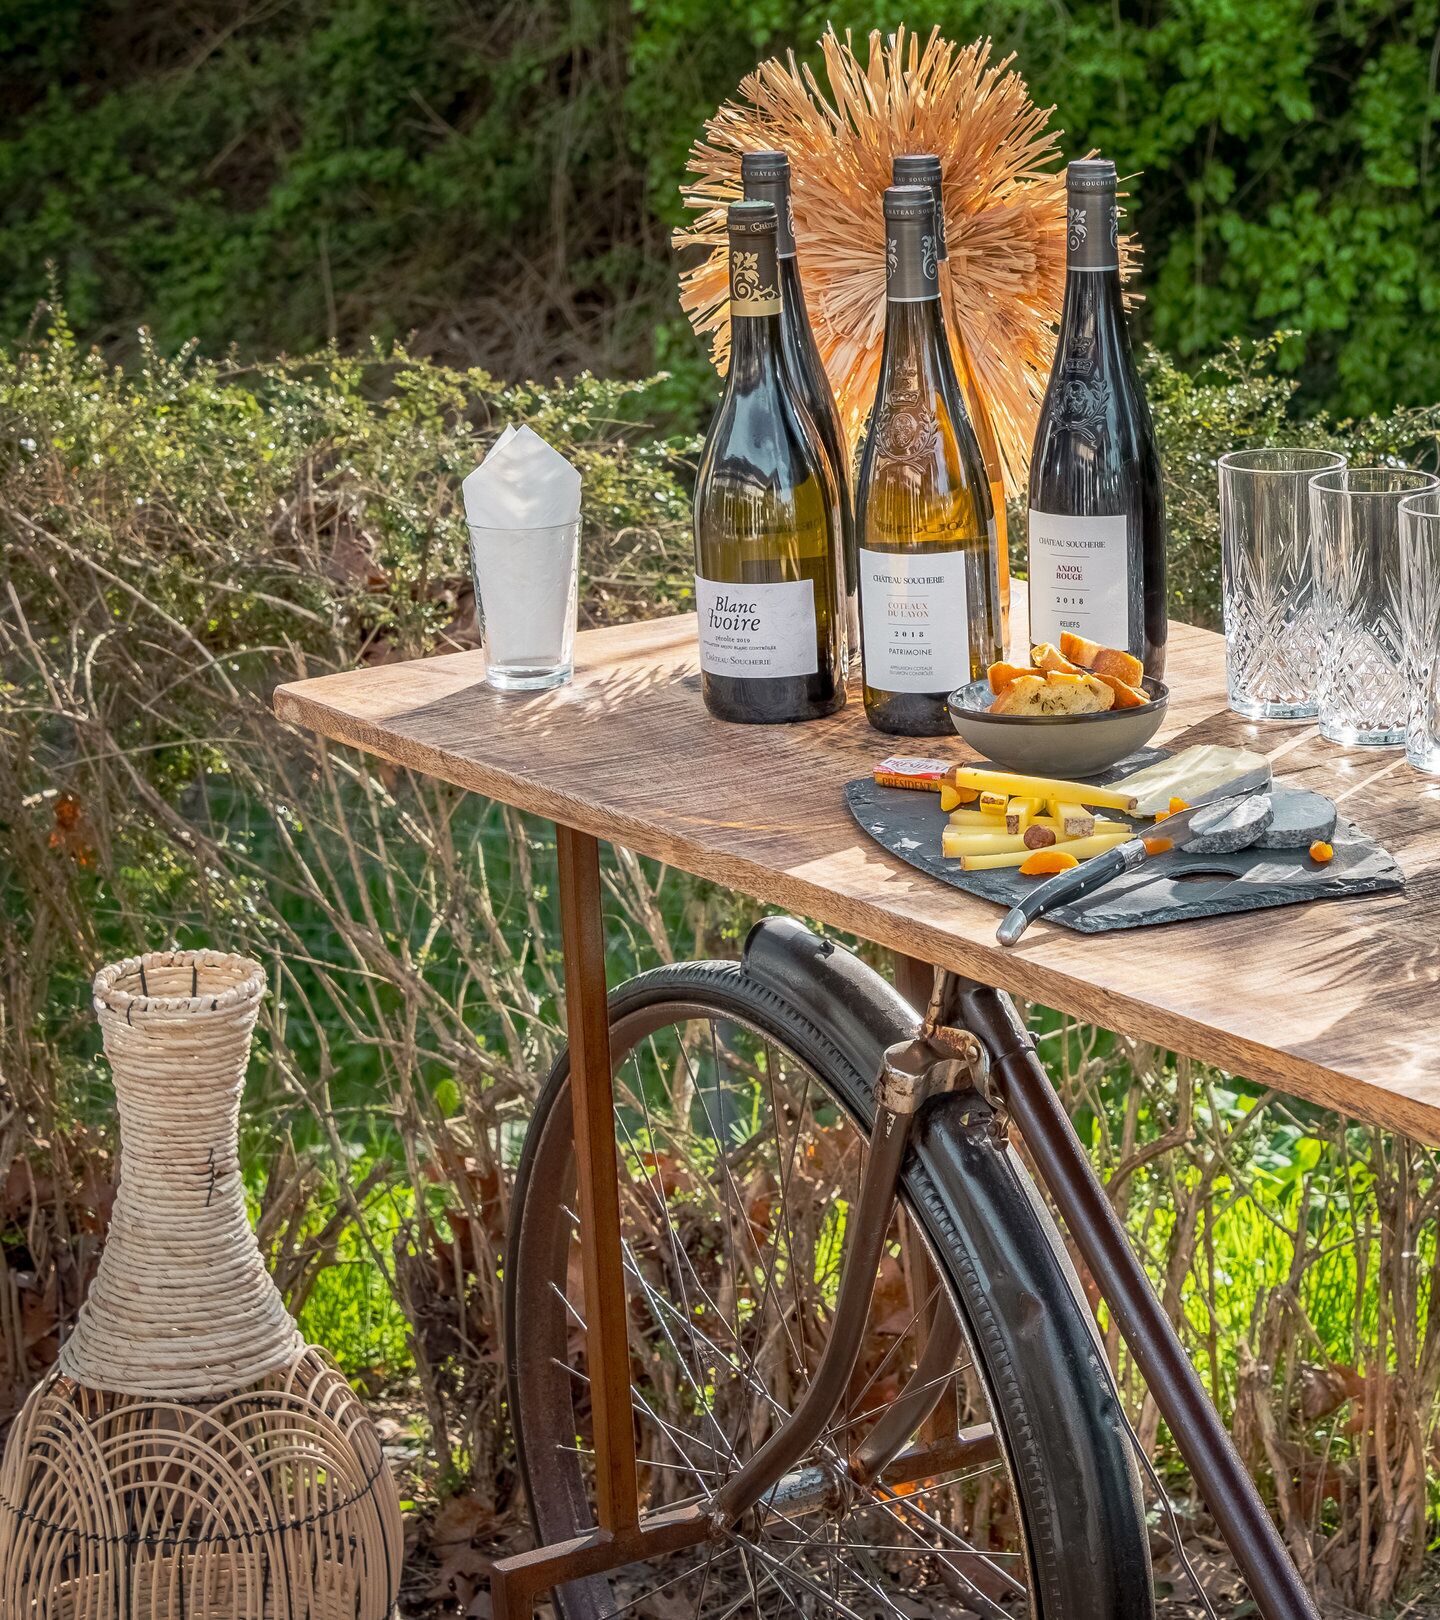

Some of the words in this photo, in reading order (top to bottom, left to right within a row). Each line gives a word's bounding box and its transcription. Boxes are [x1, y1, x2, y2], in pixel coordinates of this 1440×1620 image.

[1038, 537, 1065, 547] CHÂTEAU
[1066, 540, 1106, 549] SOUCHERIE
[1056, 565, 1083, 573] ANJOU
[872, 574, 902, 584] CHÂTEAU
[903, 576, 945, 585] SOUCHERIE
[1056, 572, 1083, 581] ROUGE
[715, 596, 757, 614] Blanc
[900, 610, 930, 618] LAYON
[708, 607, 761, 631] Ivoire
[1059, 620, 1081, 628] RELIEFS
[889, 648, 933, 656] PATRIMOINE
